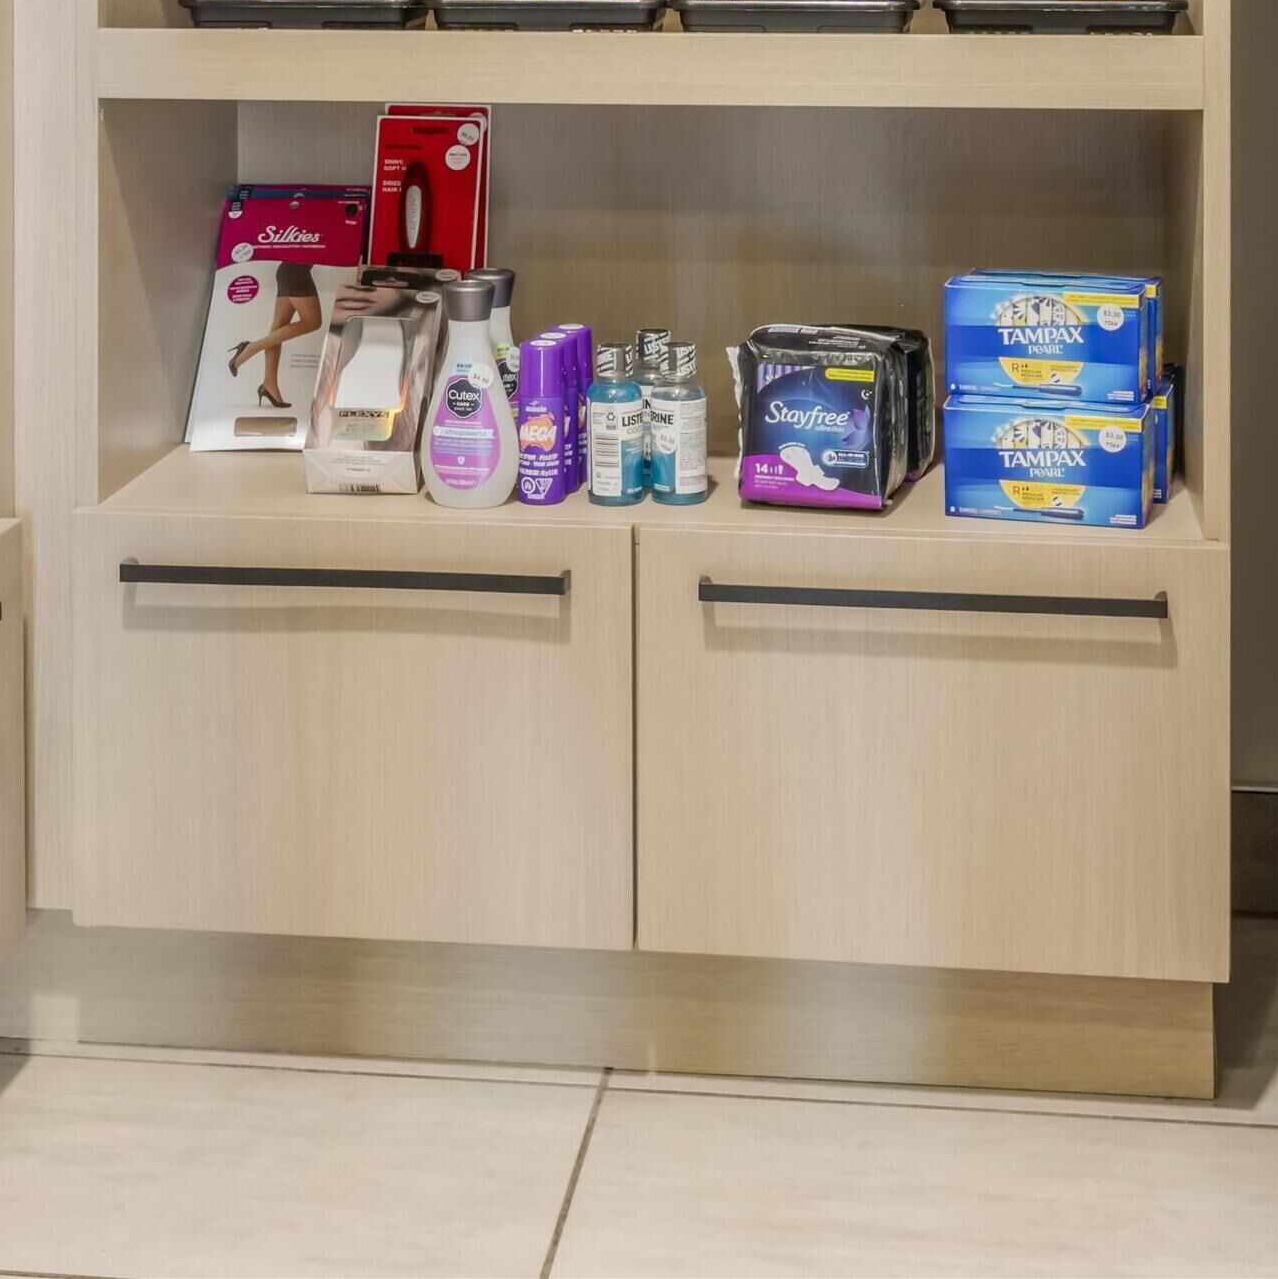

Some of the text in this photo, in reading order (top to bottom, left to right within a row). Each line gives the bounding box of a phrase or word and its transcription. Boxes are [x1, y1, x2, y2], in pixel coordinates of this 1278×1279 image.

[258, 225, 320, 243] Silkies
[998, 326, 1084, 345] TAMPAX
[1011, 363, 1019, 372] R
[449, 390, 480, 400] Cutex
[765, 401, 849, 429] Stayfree
[998, 450, 1087, 467] TAMPAX
[755, 463, 768, 474] 14
[1013, 486, 1020, 495] R
